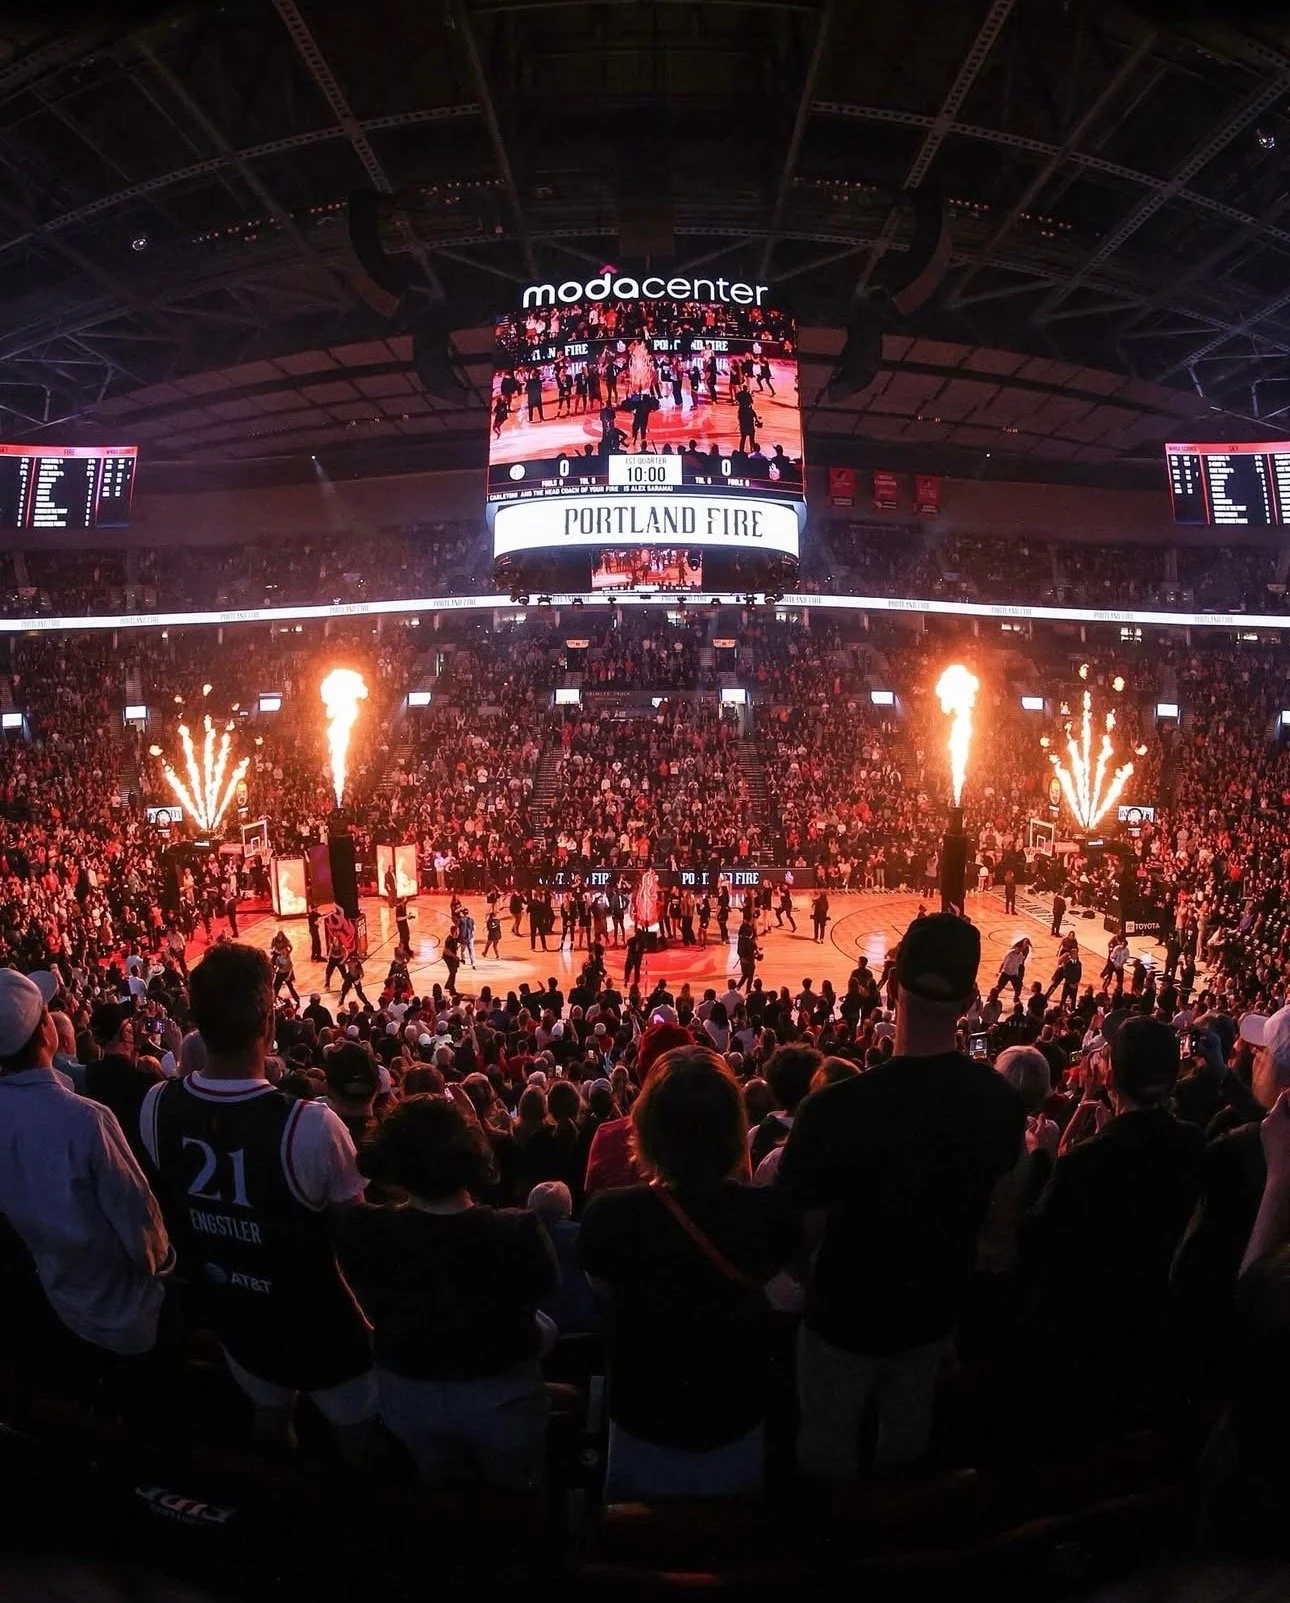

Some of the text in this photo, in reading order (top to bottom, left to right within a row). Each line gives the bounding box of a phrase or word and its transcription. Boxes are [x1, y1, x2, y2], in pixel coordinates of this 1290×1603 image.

[564, 343, 589, 356] FIRE
[559, 459, 570, 477] 0
[625, 457, 667, 465] 1ST QUARTER
[721, 459, 732, 477] 0
[627, 466, 666, 482] 10:00
[561, 487, 580, 495] COACH
[564, 506, 763, 538] PORTLAND FIRE
[735, 872, 759, 885] FIRE
[1135, 922, 1160, 930] TOYOTA
[181, 1135, 254, 1208] 21
[189, 1207, 264, 1245] ENGSTLER
[230, 1271, 272, 1294] AT&T
